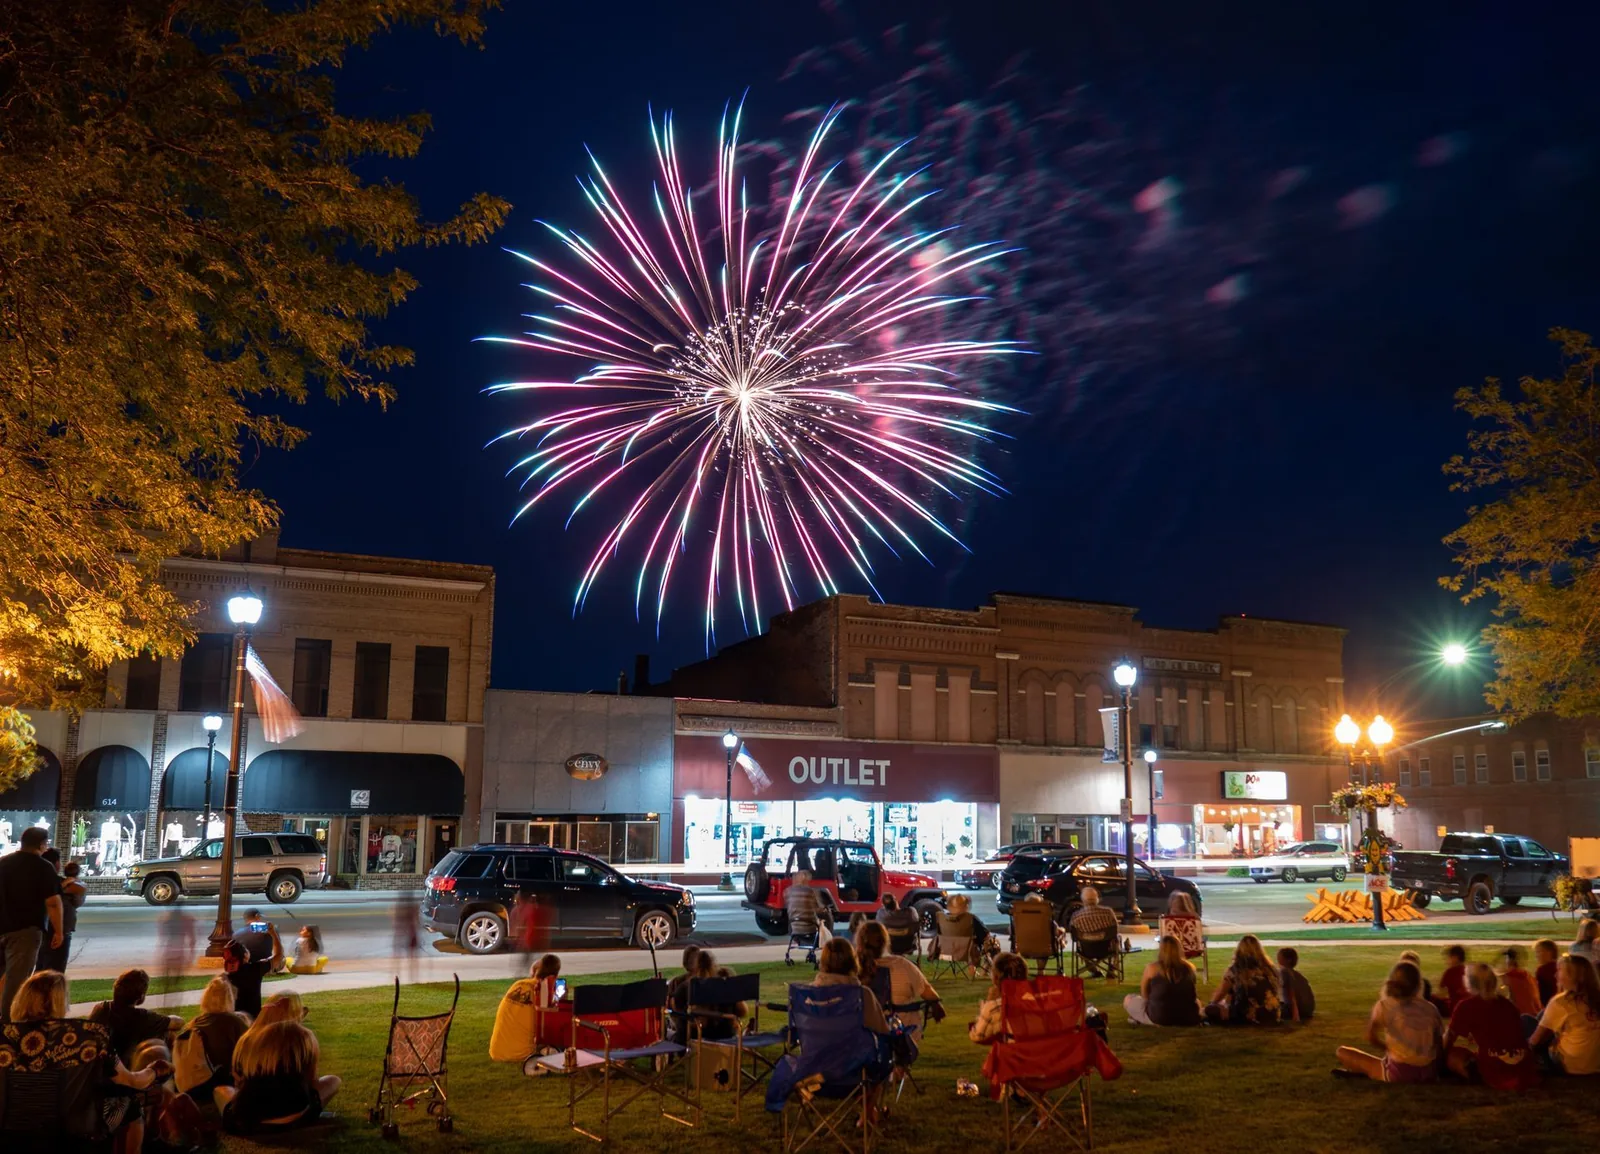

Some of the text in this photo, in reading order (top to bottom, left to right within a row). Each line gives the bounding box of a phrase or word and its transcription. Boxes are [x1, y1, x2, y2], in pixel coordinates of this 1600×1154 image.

[573, 756, 602, 778] envy
[788, 756, 891, 786] OUTLET
[102, 798, 117, 806] 614
